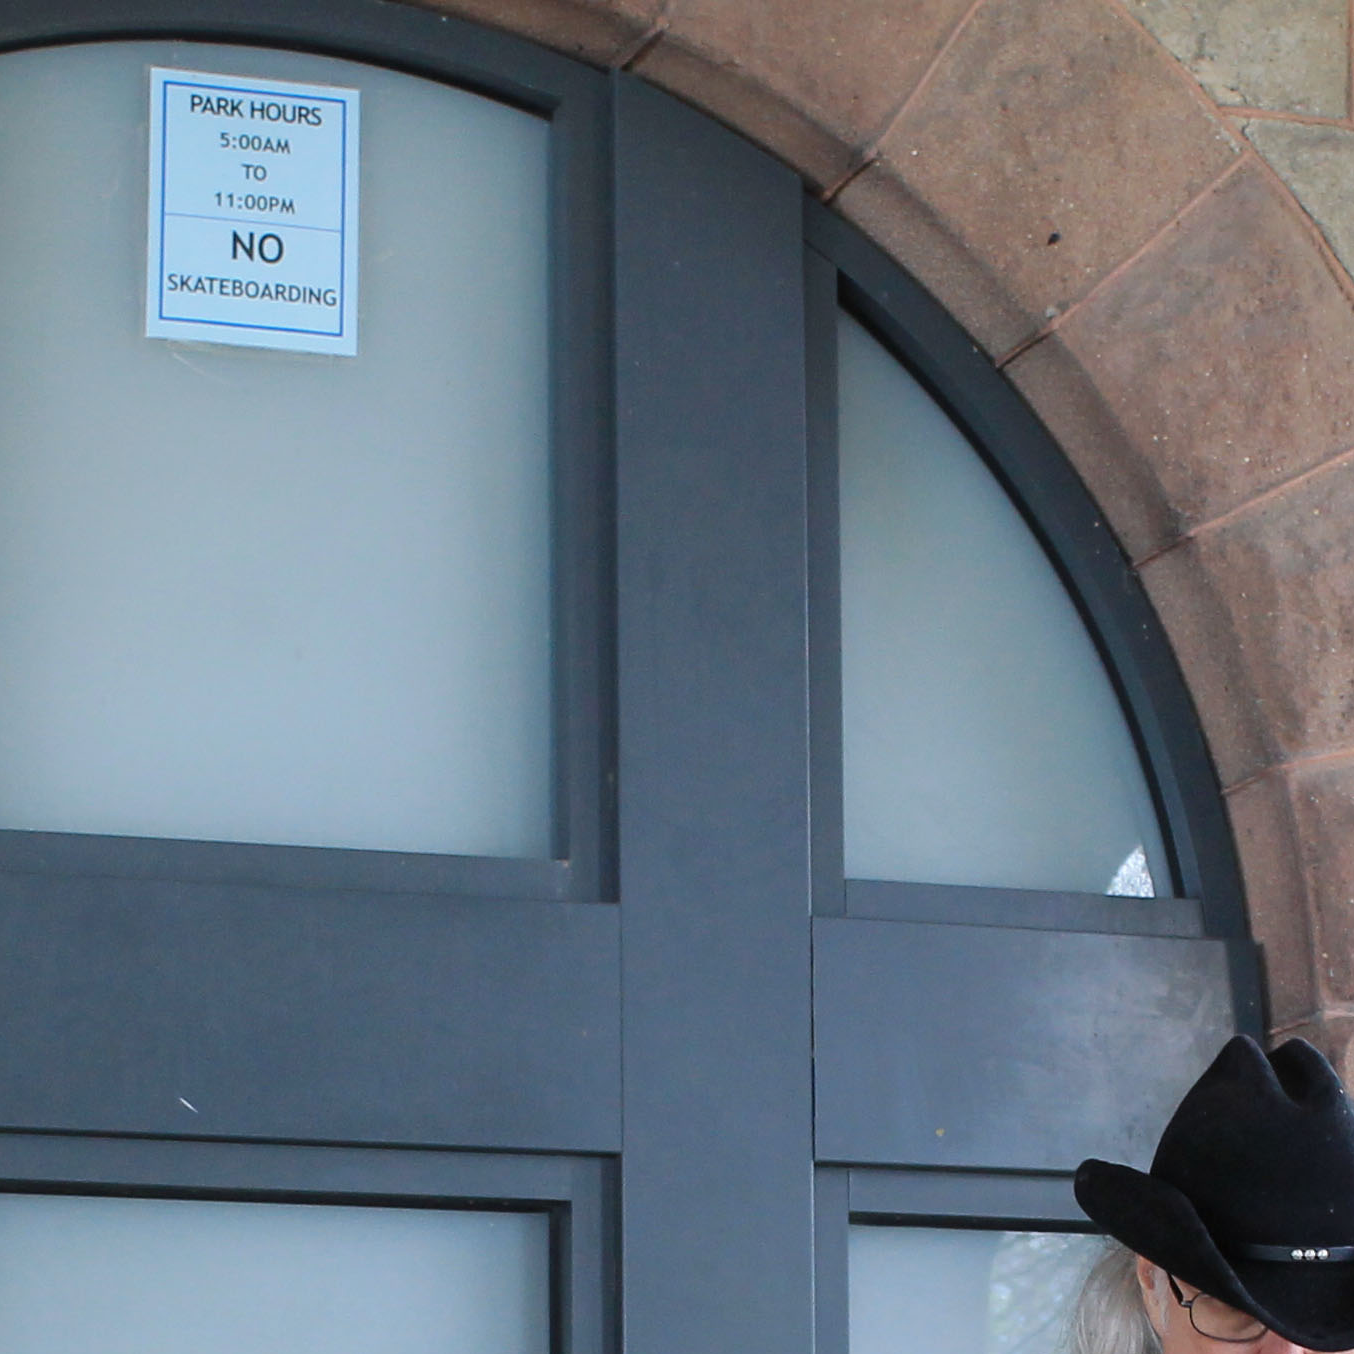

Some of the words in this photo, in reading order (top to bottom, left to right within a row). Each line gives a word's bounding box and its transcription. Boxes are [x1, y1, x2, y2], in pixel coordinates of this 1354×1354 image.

[190, 94, 244, 119] PARK
[250, 102, 322, 126] HOURS
[219, 132, 291, 154] 5:00AM
[242, 164, 267, 182] TO
[215, 192, 296, 214] 11:00PM
[231, 230, 284, 264] NO
[167, 273, 337, 307] SKATEBOARDING
